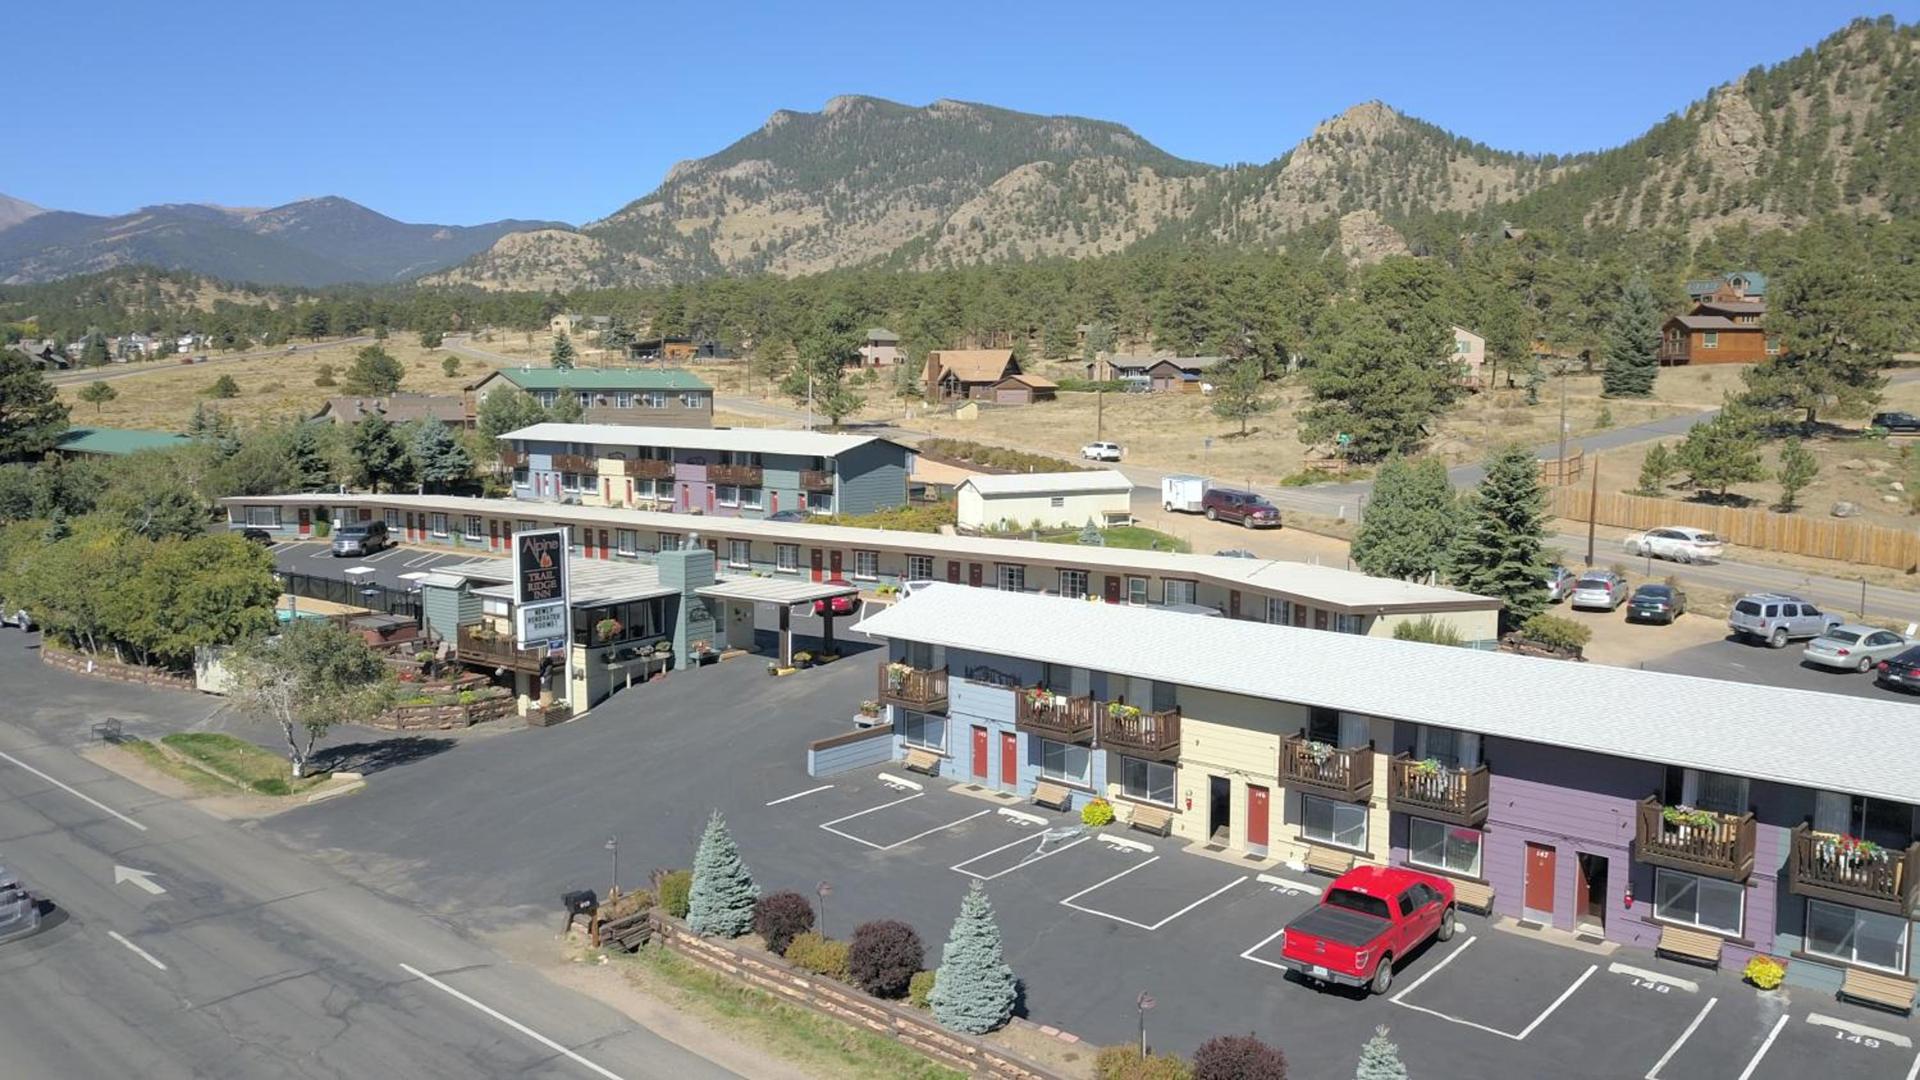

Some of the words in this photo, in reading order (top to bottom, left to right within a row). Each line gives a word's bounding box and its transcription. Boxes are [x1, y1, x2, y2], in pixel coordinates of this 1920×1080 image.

[522, 536, 559, 561] Alpine
[529, 571, 555, 582] TRAIL
[528, 579, 558, 592] RIDGE
[533, 589, 552, 600] INN
[1834, 1030, 1881, 1049] 149
